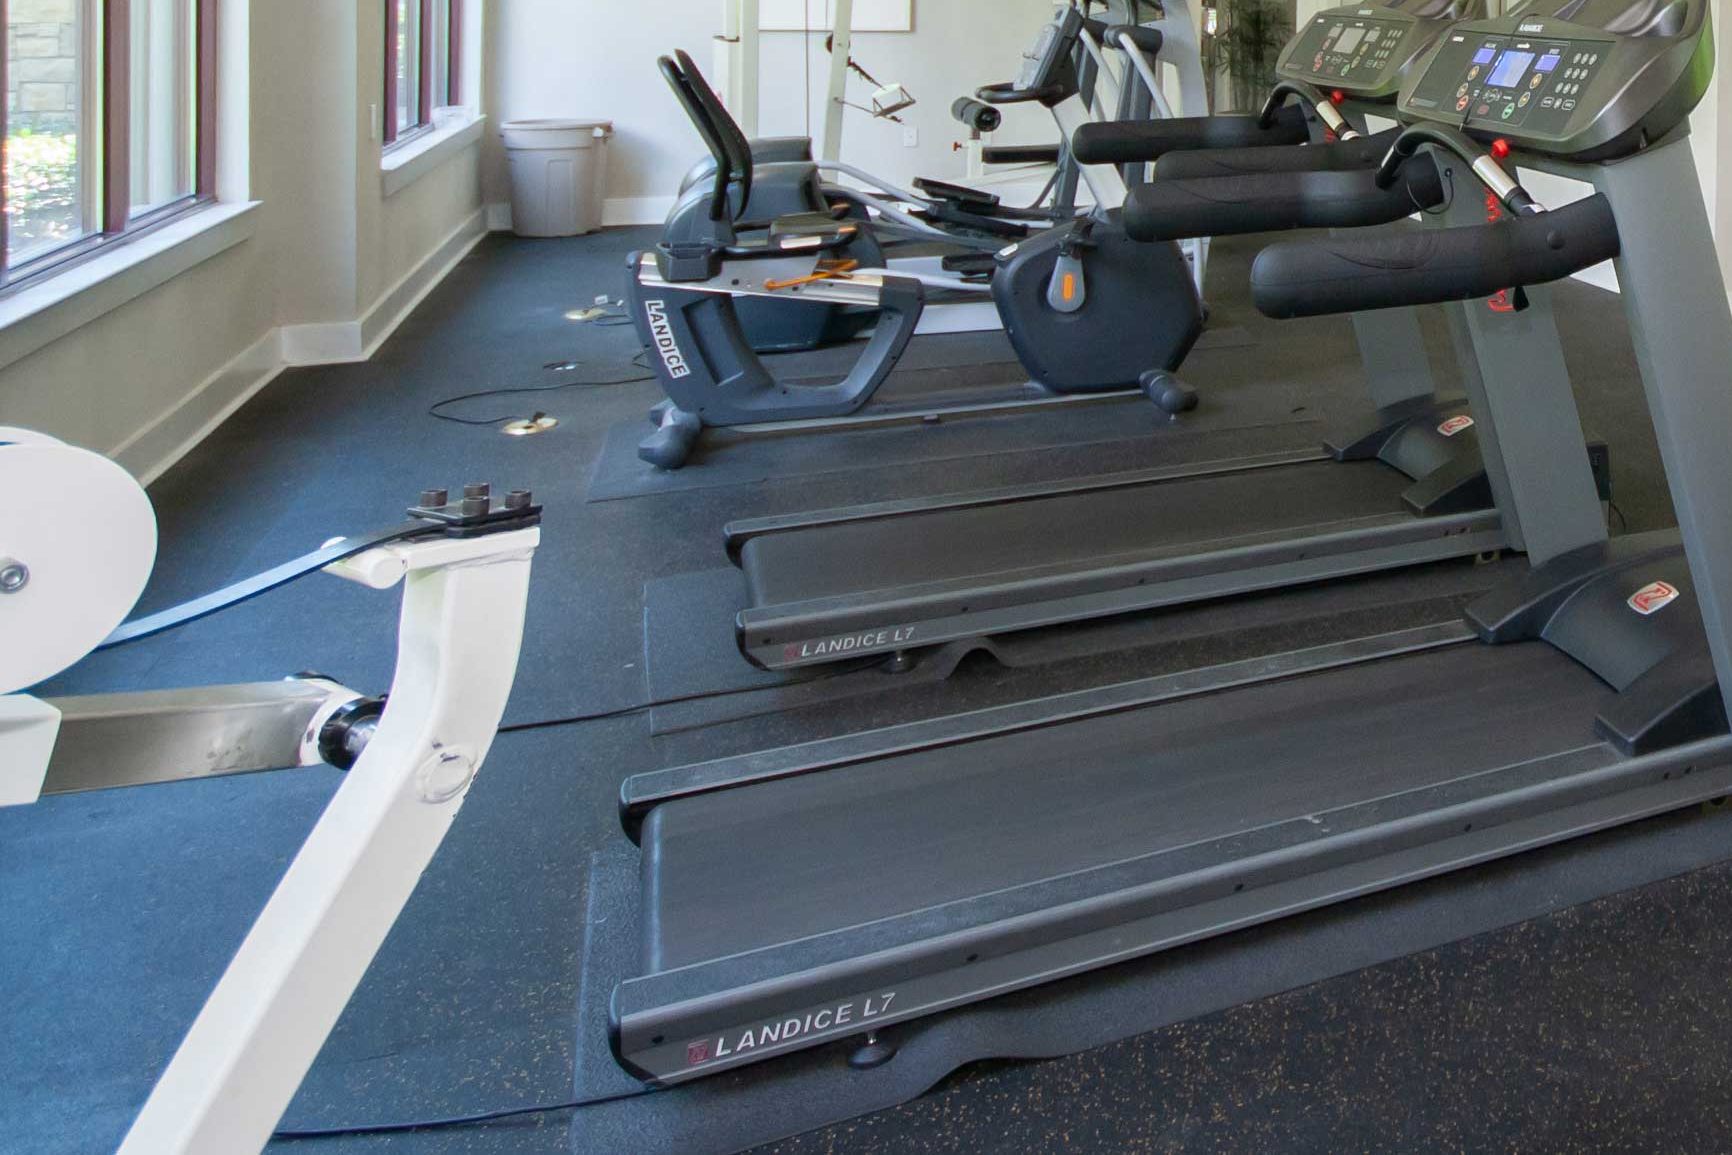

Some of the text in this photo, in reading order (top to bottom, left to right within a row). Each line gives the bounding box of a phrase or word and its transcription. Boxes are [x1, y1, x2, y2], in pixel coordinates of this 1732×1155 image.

[646, 300, 689, 378] LANDICE
[801, 627, 915, 657] LANDICE L7
[715, 992, 896, 1057] LANDICE L7
